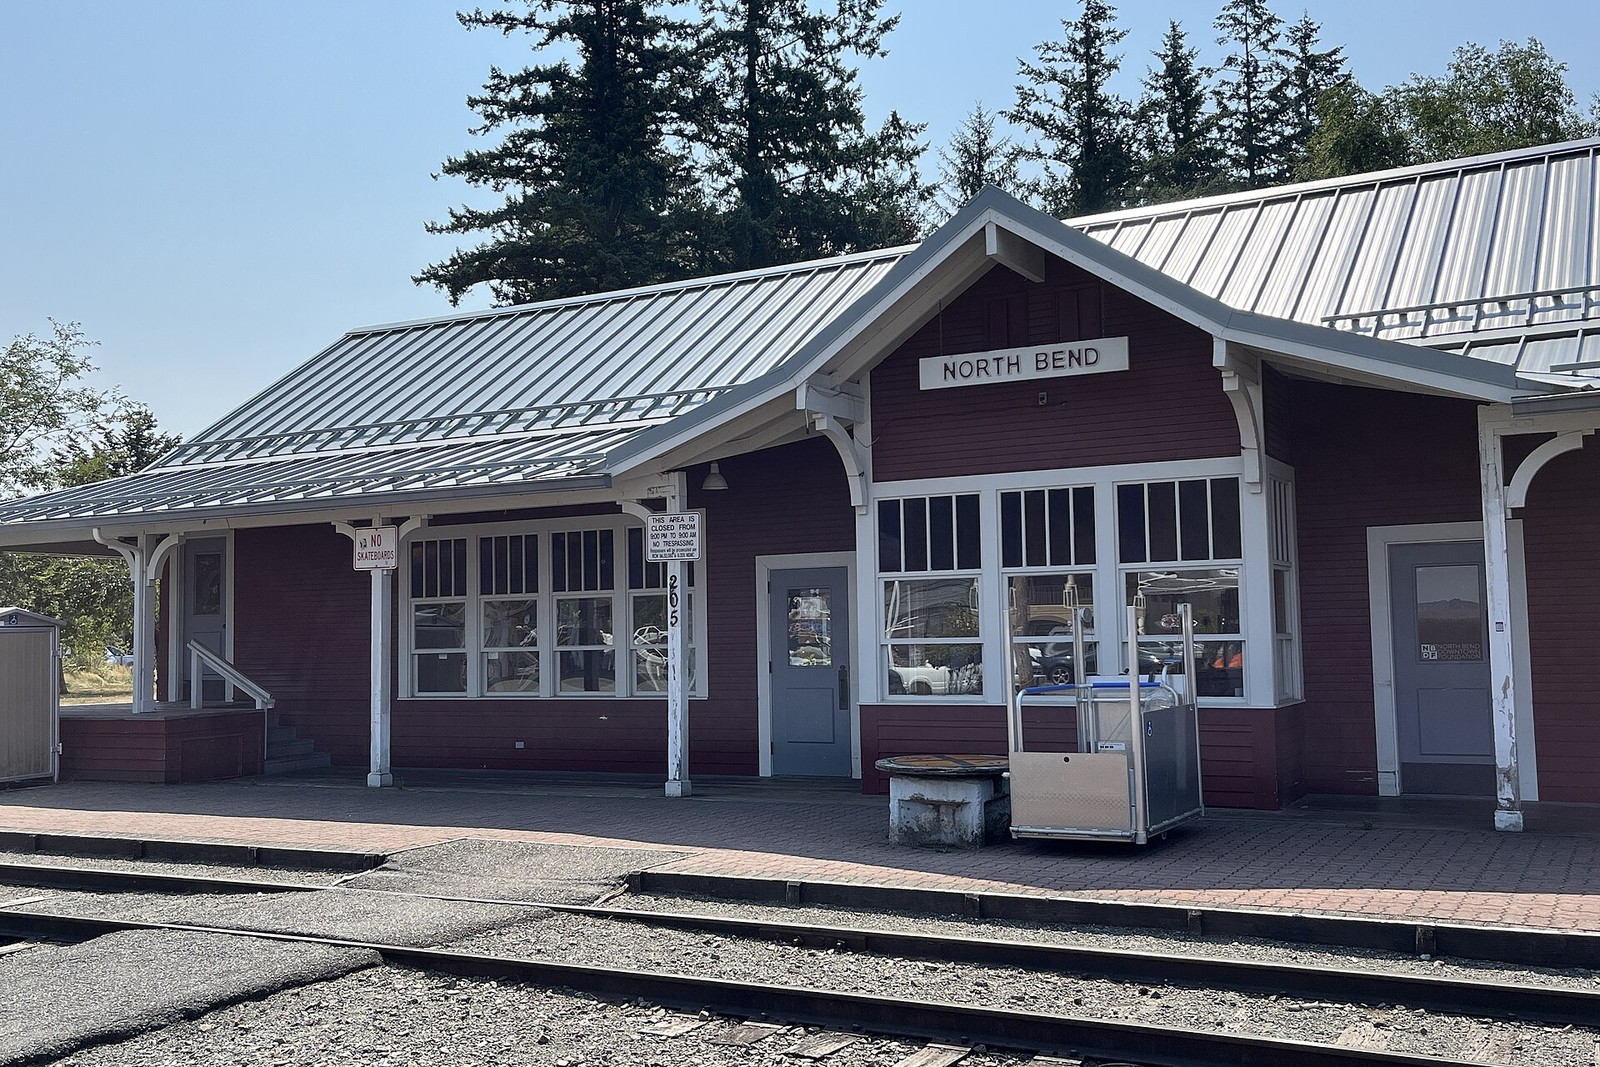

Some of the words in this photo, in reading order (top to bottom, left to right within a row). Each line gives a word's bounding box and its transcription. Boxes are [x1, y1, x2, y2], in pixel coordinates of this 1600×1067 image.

[943, 354, 1021, 381] NORTH
[1035, 347, 1100, 371] BEND
[371, 534, 382, 547] NO
[357, 550, 395, 561] SKATEBOARDS
[669, 574, 679, 627] 205
